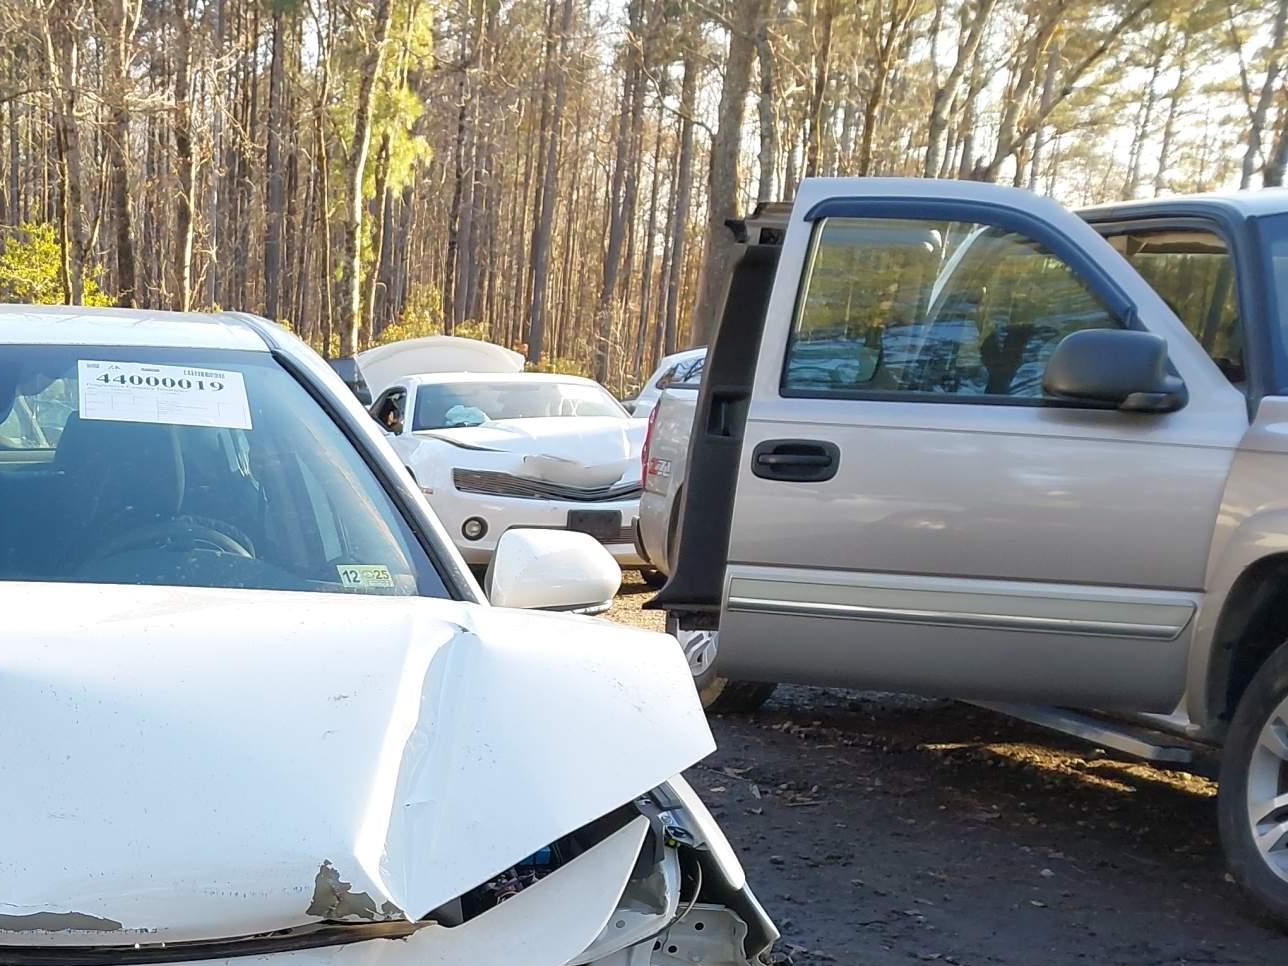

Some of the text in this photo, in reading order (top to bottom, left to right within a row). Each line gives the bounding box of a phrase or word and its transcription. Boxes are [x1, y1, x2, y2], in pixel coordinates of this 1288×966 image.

[96, 373, 225, 392] 44000019
[342, 569, 390, 583] 12 25
